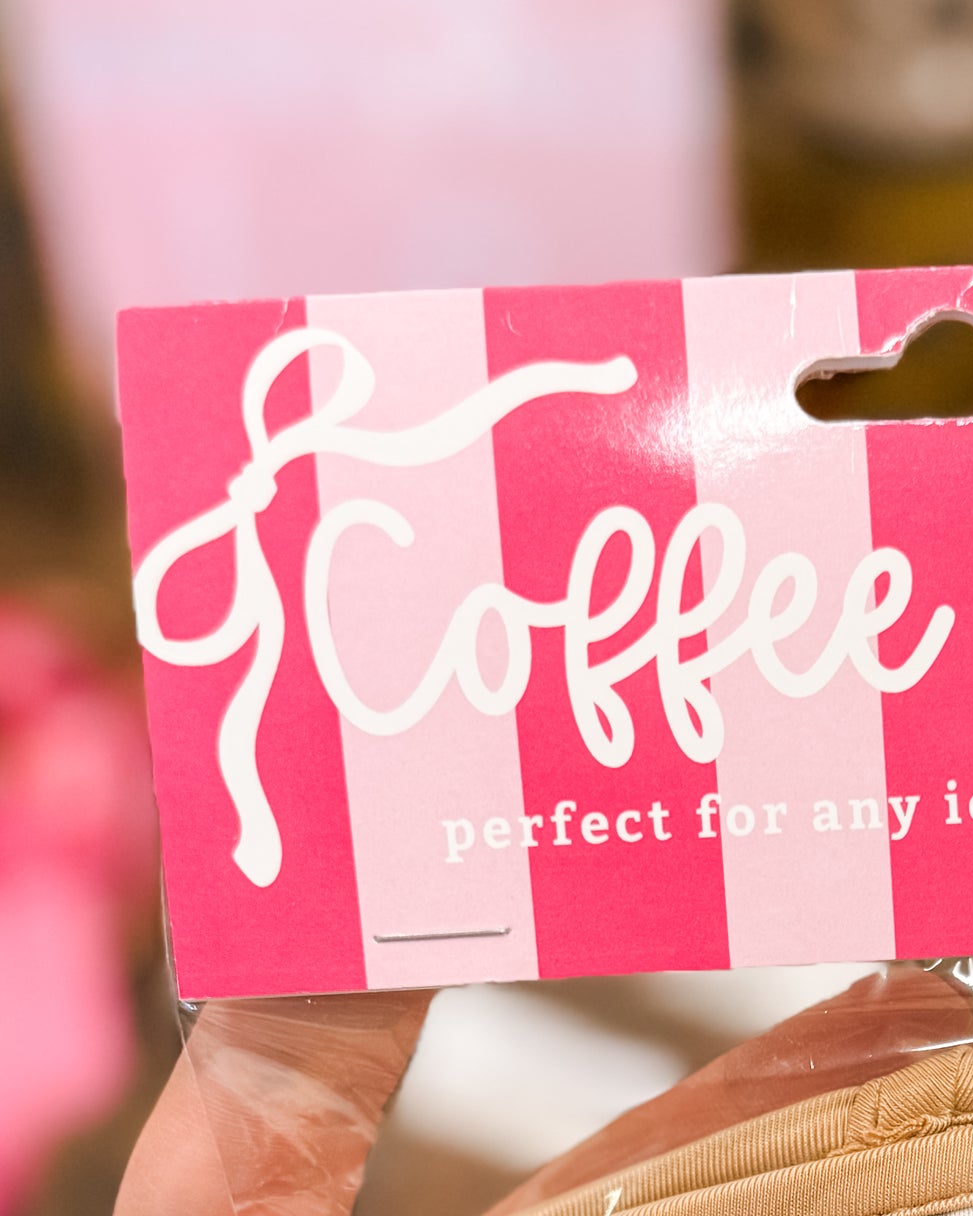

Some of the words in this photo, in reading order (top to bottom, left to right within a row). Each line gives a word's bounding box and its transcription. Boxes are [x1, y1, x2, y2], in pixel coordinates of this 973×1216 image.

[304, 499, 956, 768] Coffee
[442, 799, 670, 864] perfect
[696, 794, 788, 840] for
[811, 790, 922, 842] any
